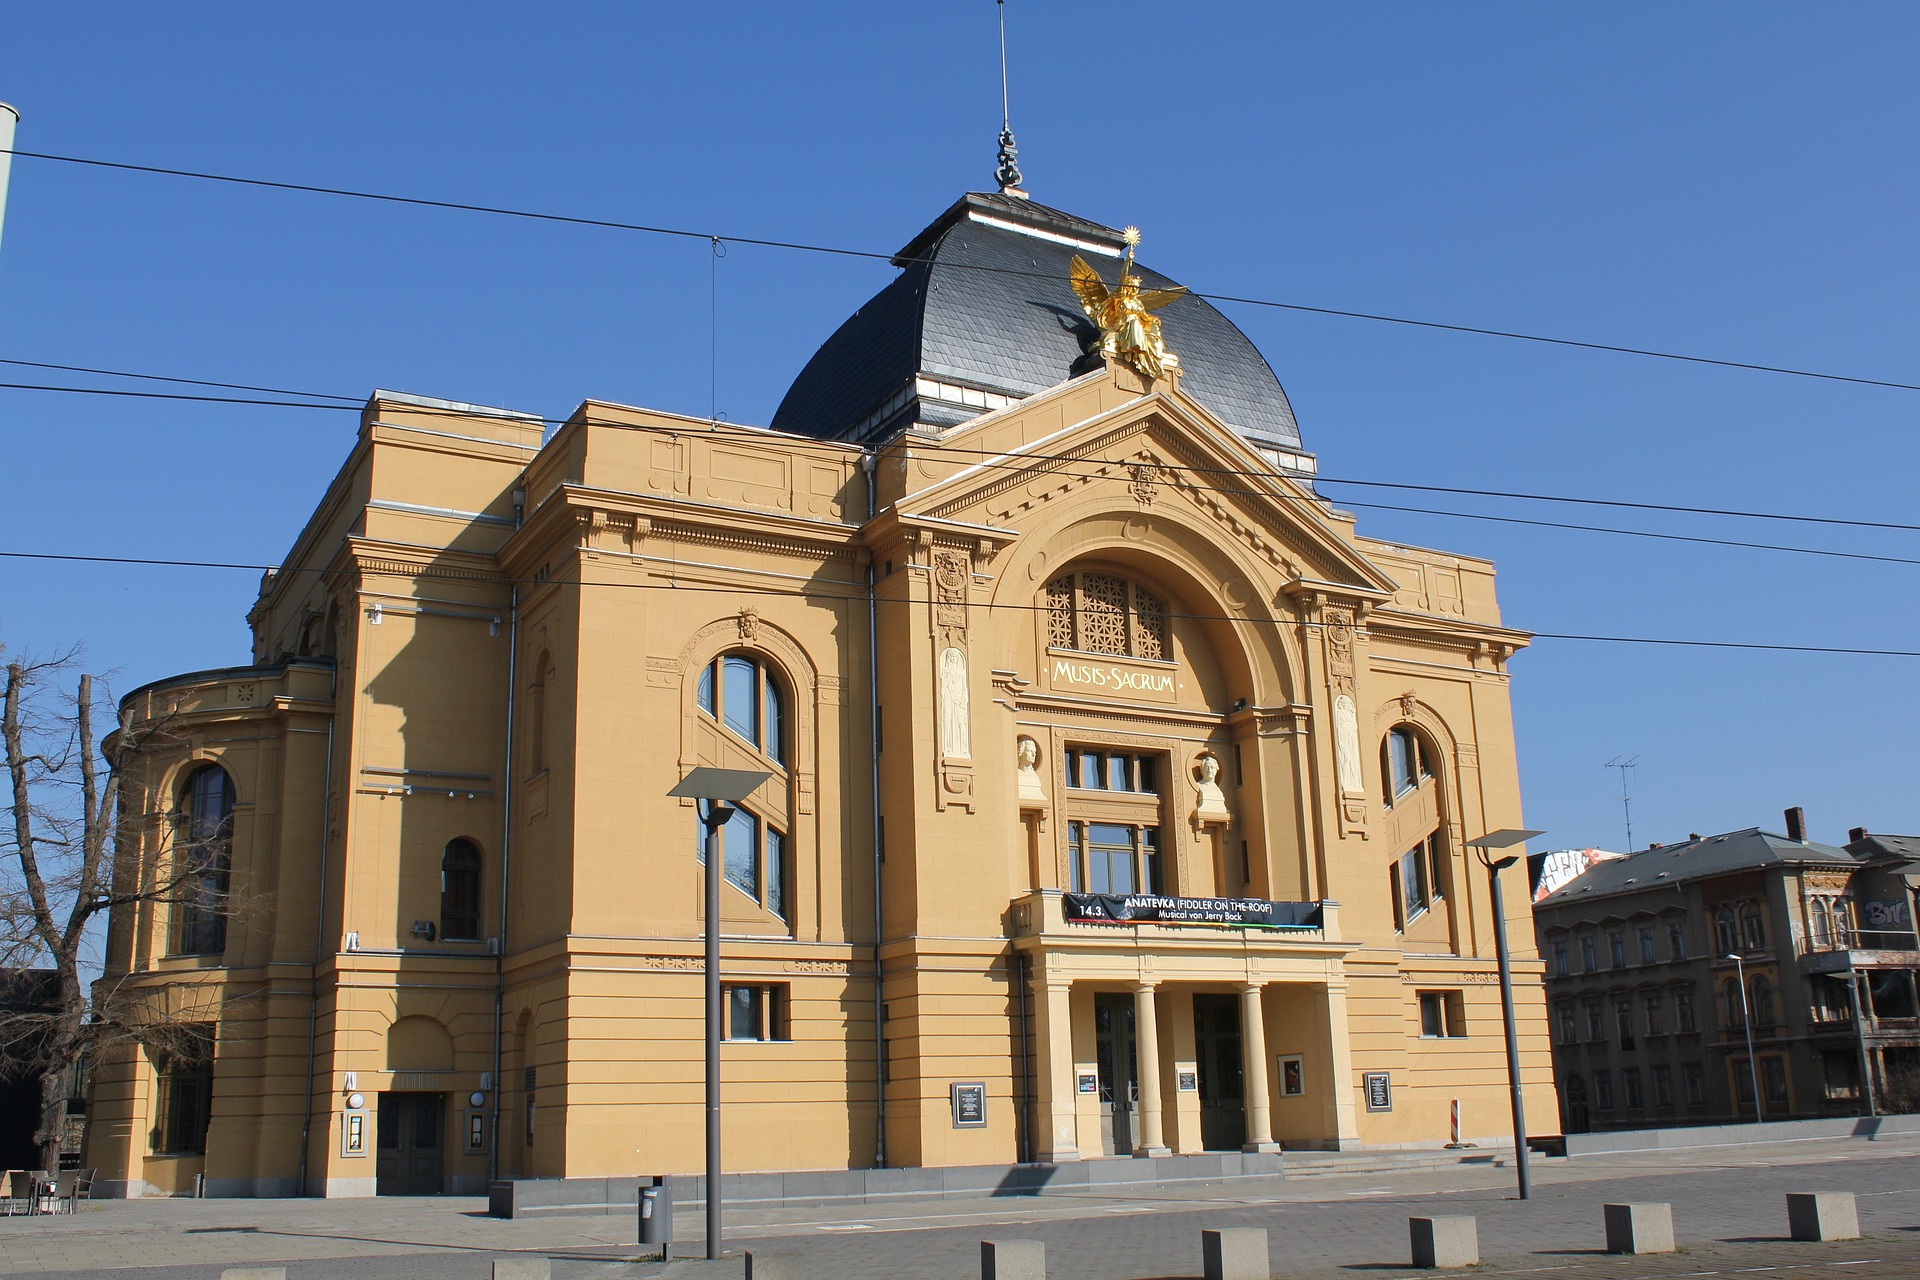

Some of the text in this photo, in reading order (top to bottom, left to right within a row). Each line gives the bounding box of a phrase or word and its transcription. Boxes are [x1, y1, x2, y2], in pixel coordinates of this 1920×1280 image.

[1124, 897, 1175, 909] ANATEVKA
[1177, 899, 1213, 911] (FIDDLER
[1214, 900, 1228, 911] ON
[1079, 905, 1105, 917] 14.3.
[1158, 909, 1243, 922] Musical von Jerry Bock
